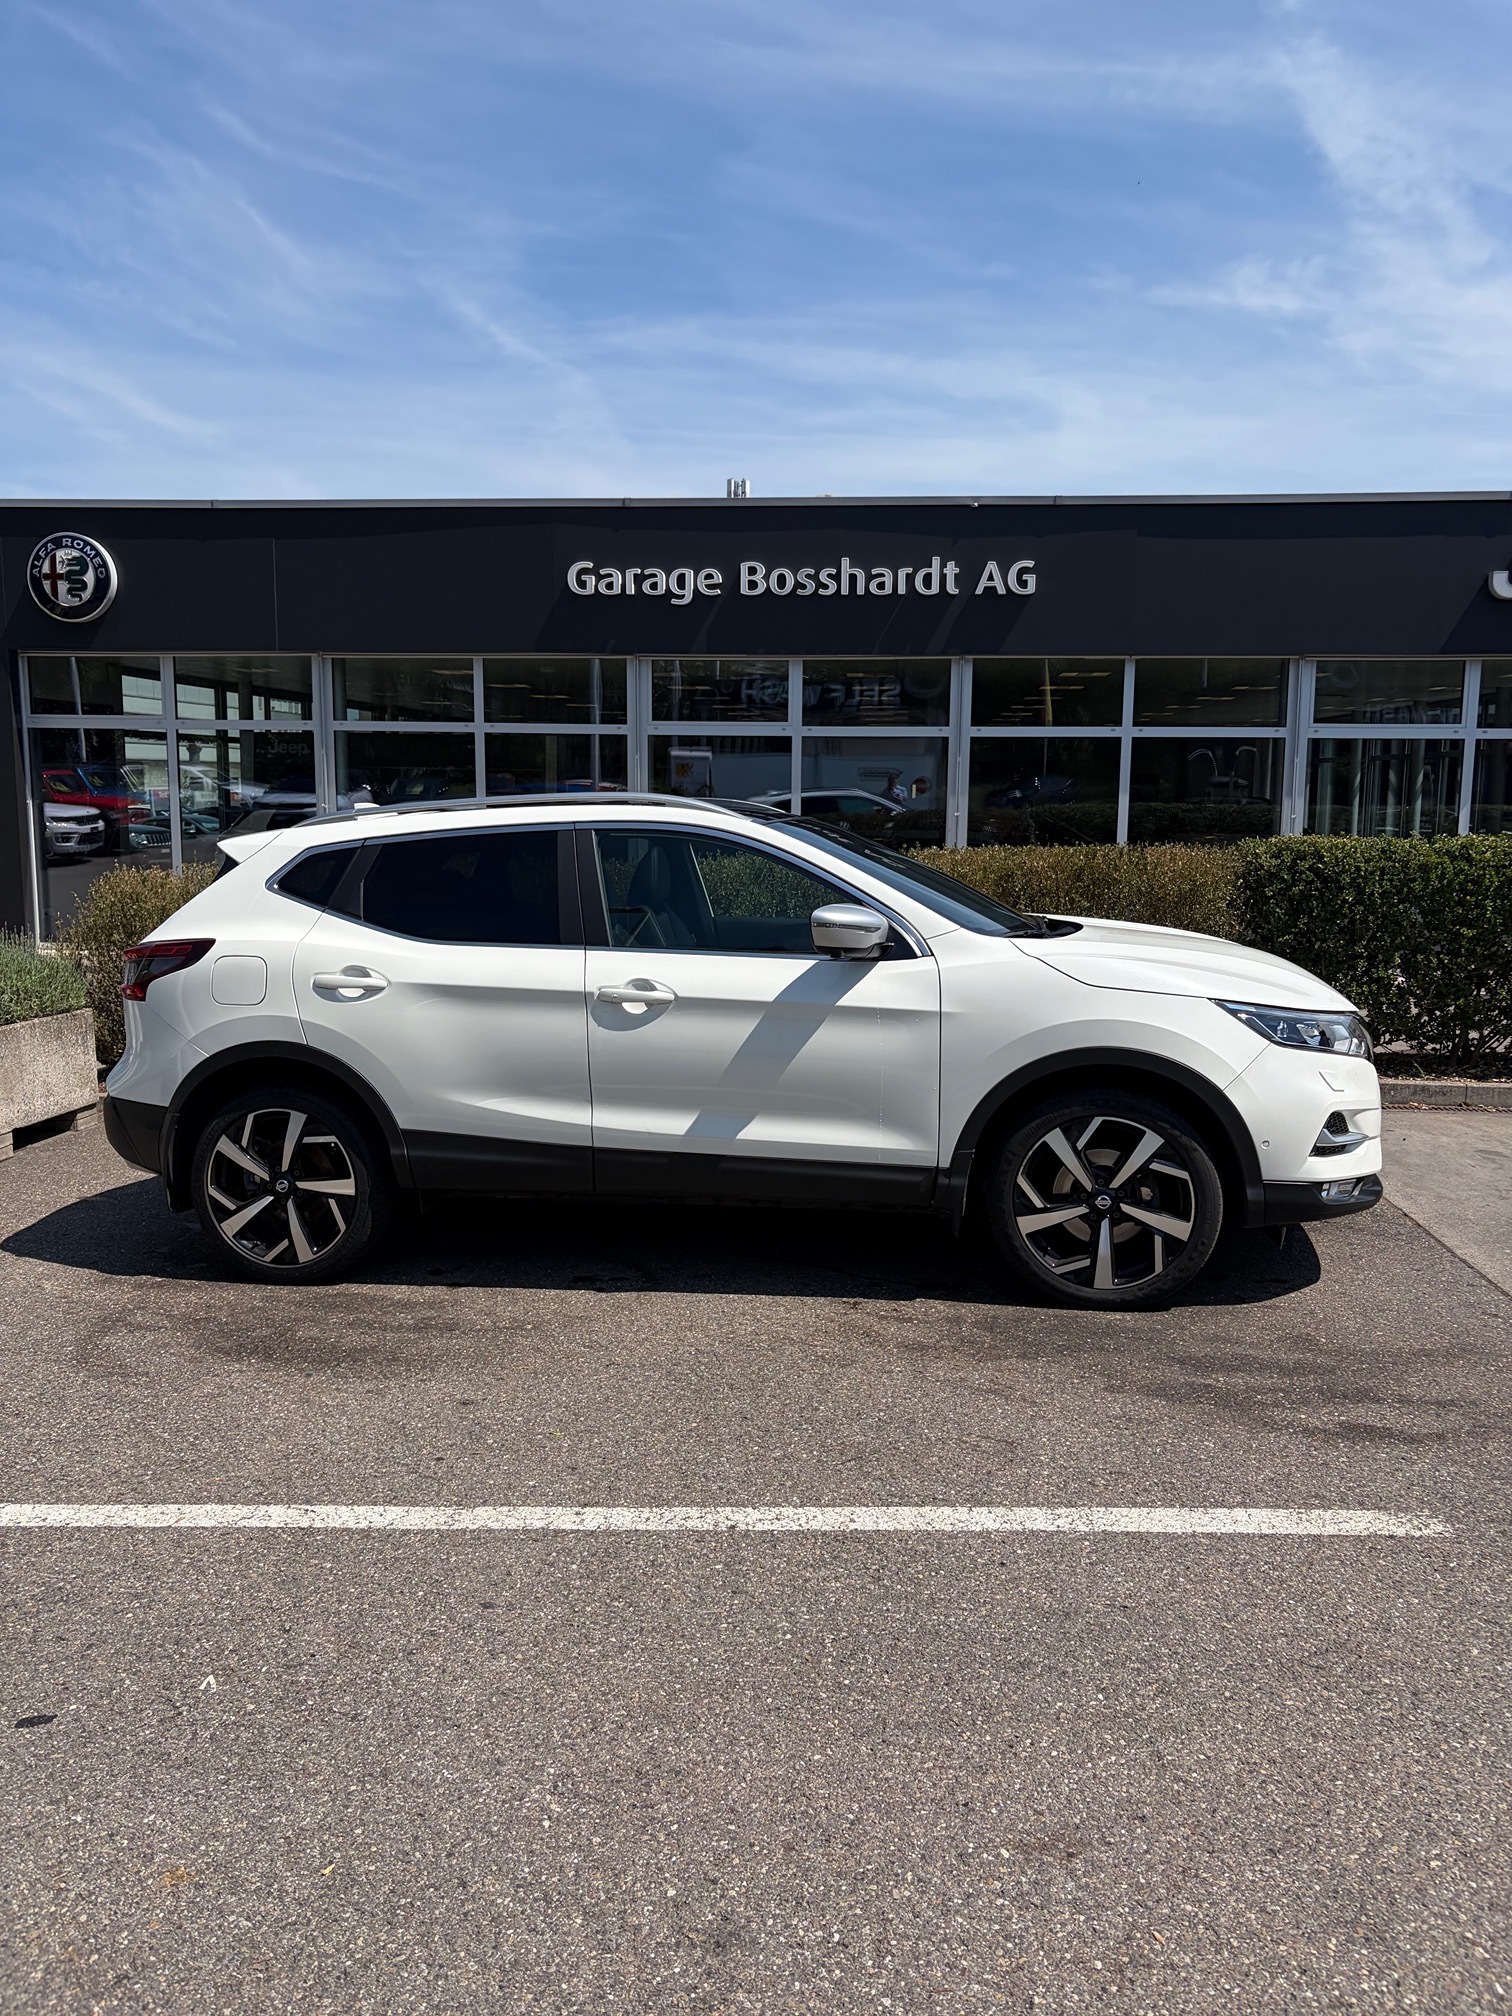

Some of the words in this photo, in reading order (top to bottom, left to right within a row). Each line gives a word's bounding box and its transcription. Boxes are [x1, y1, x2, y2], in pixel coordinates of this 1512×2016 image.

[33, 542, 56, 577] ALFA
[62, 538, 106, 578] ROMEO
[567, 561, 722, 605] Garage
[739, 556, 960, 596] Bosshardt
[974, 560, 1037, 596] AG
[267, 740, 309, 756] Jeep
